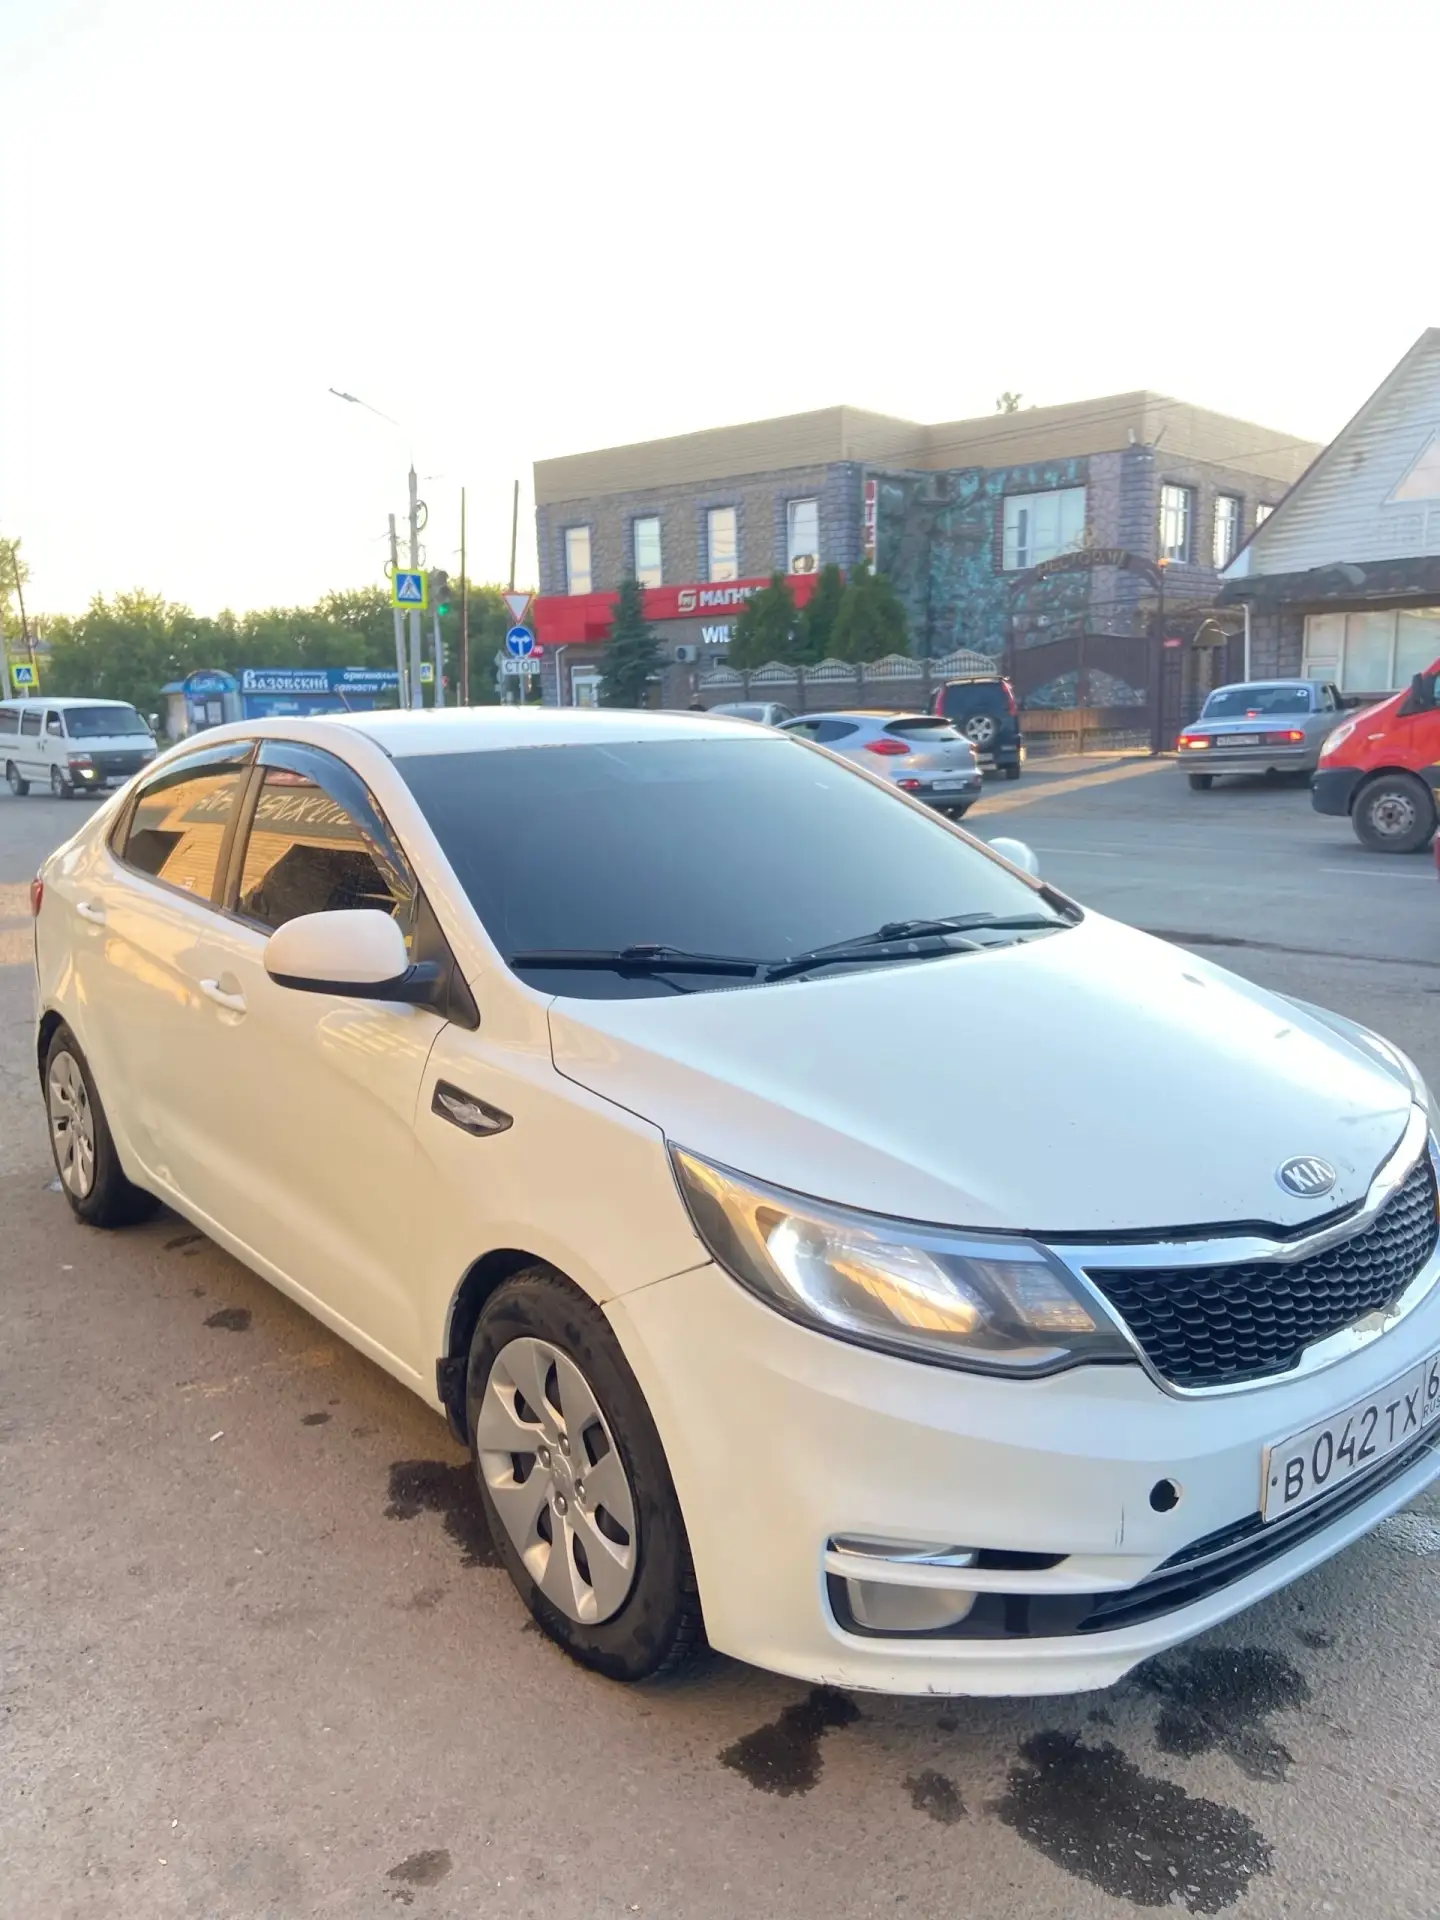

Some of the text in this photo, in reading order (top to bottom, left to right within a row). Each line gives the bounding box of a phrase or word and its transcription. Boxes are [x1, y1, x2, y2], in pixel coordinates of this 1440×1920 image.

[700, 586, 764, 606] МАГНИ
[505, 660, 538, 672] СТОП
[1285, 1160, 1332, 1190] KIA
